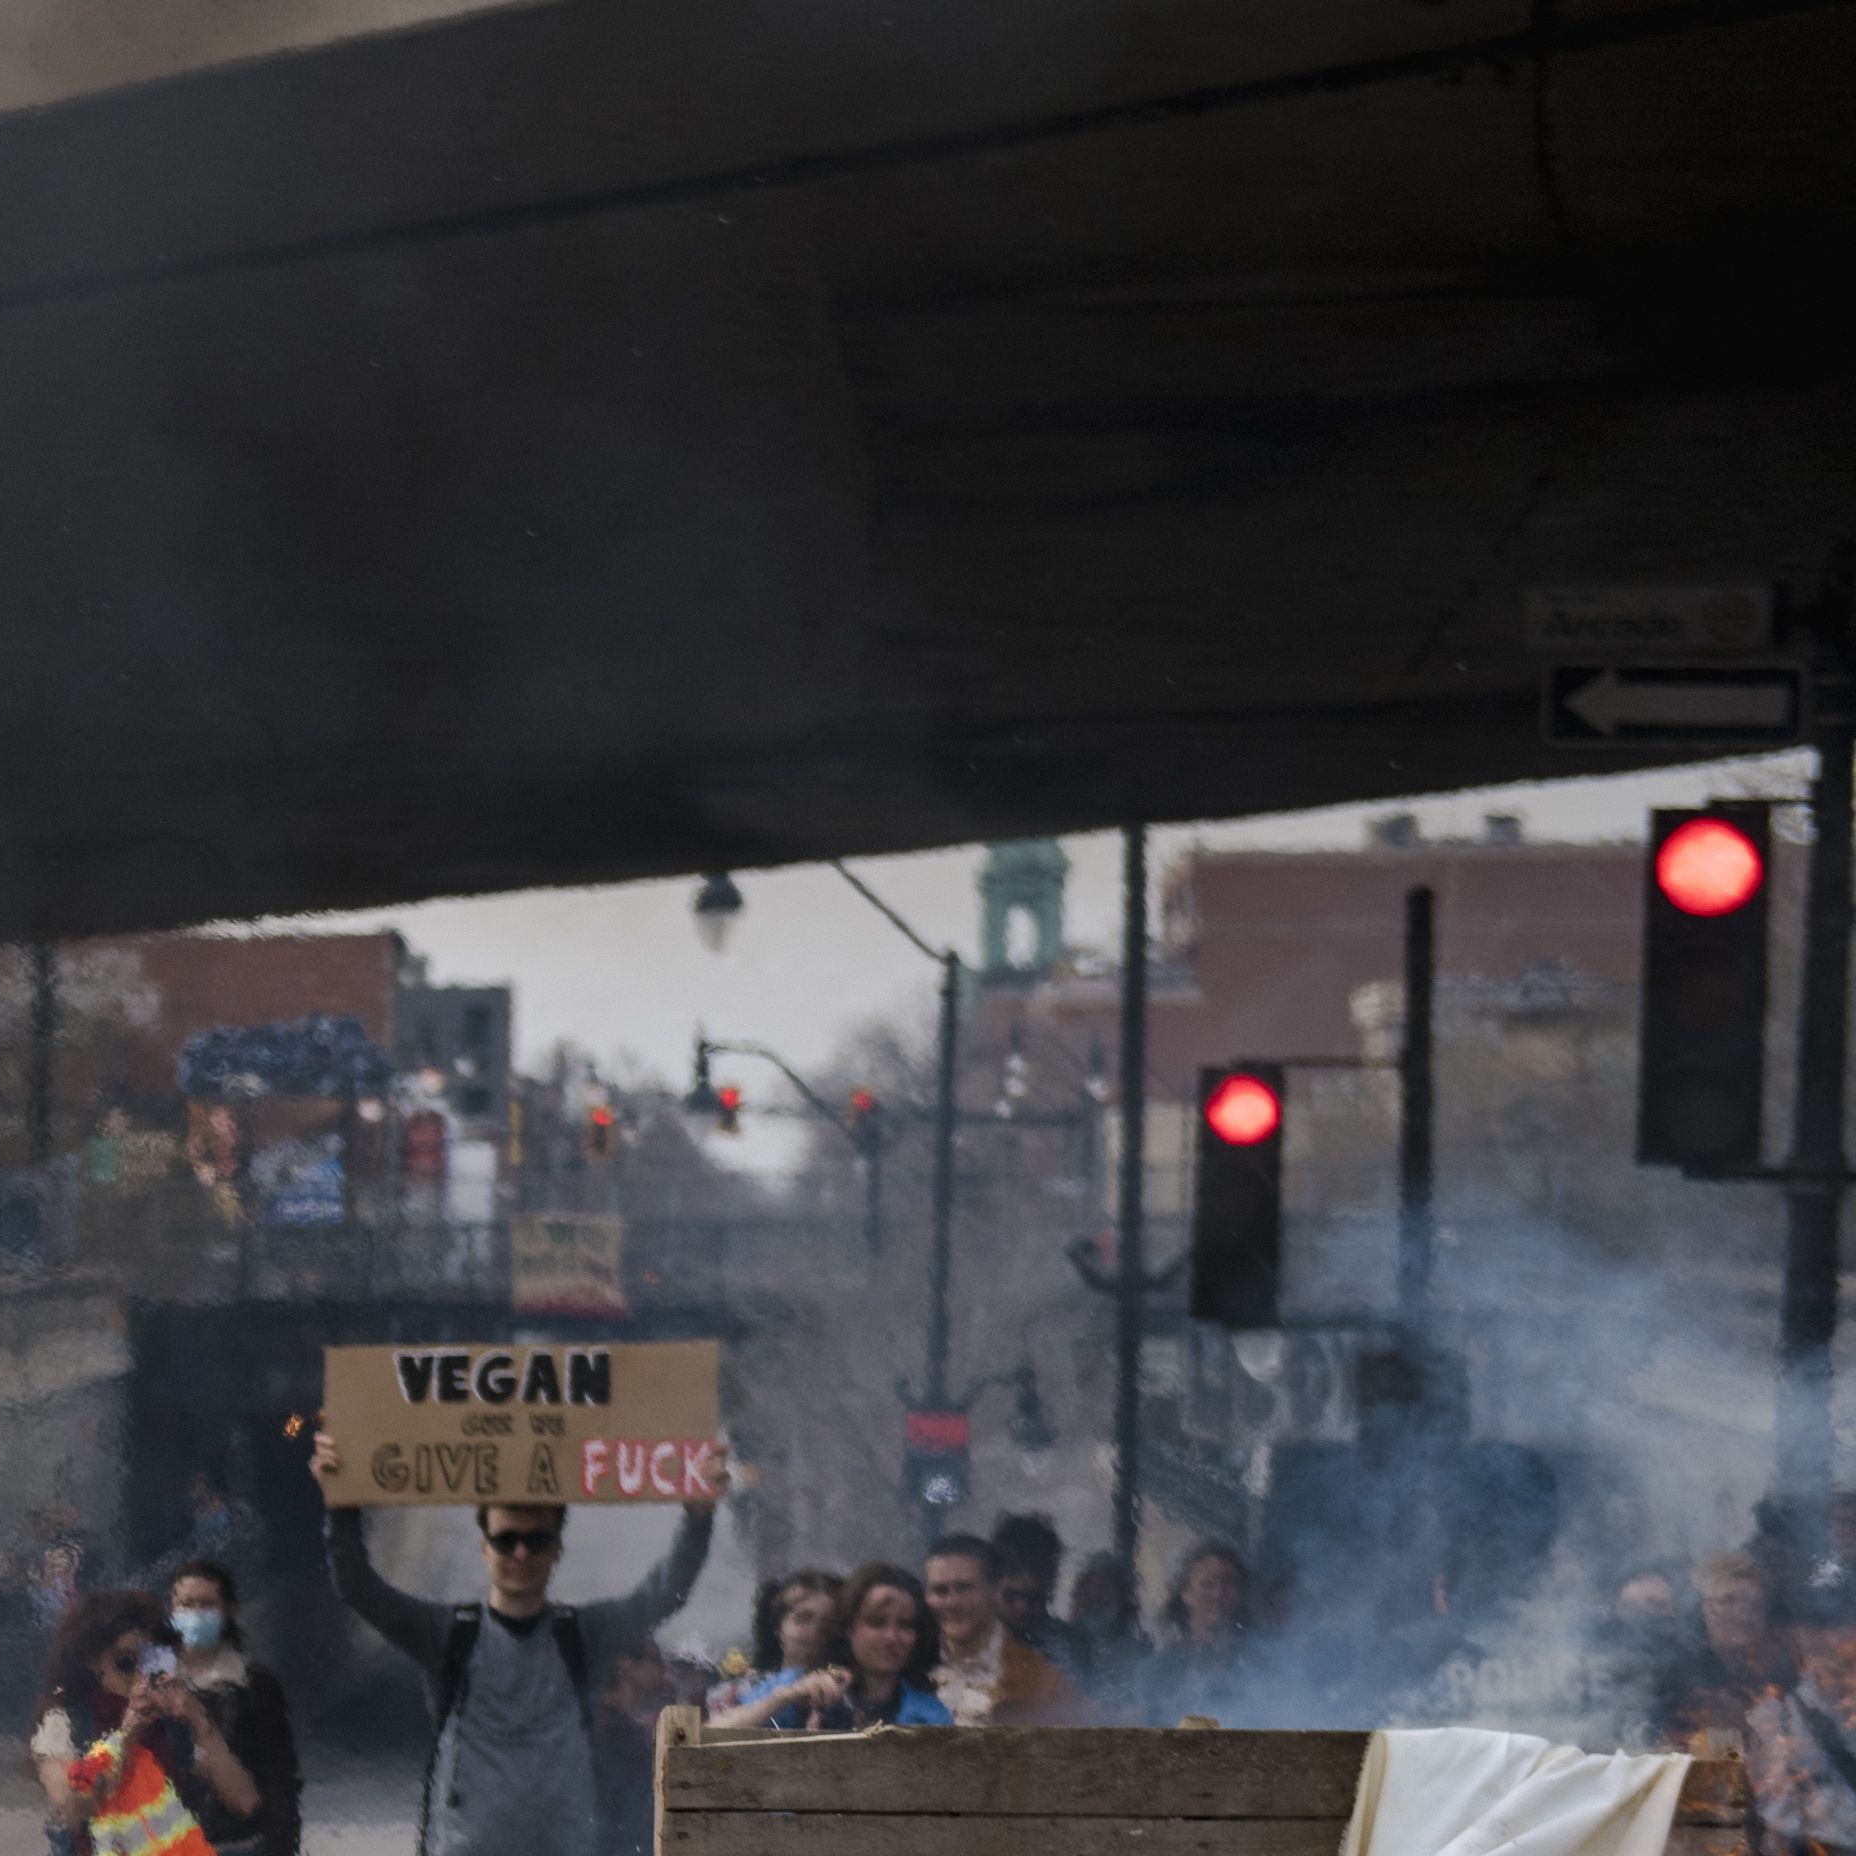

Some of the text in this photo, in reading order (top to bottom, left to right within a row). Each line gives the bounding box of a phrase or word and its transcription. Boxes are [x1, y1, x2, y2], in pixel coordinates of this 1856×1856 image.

[394, 1348, 612, 1406] VEGAN
[371, 1438, 716, 1497] GIVE A FUCK
